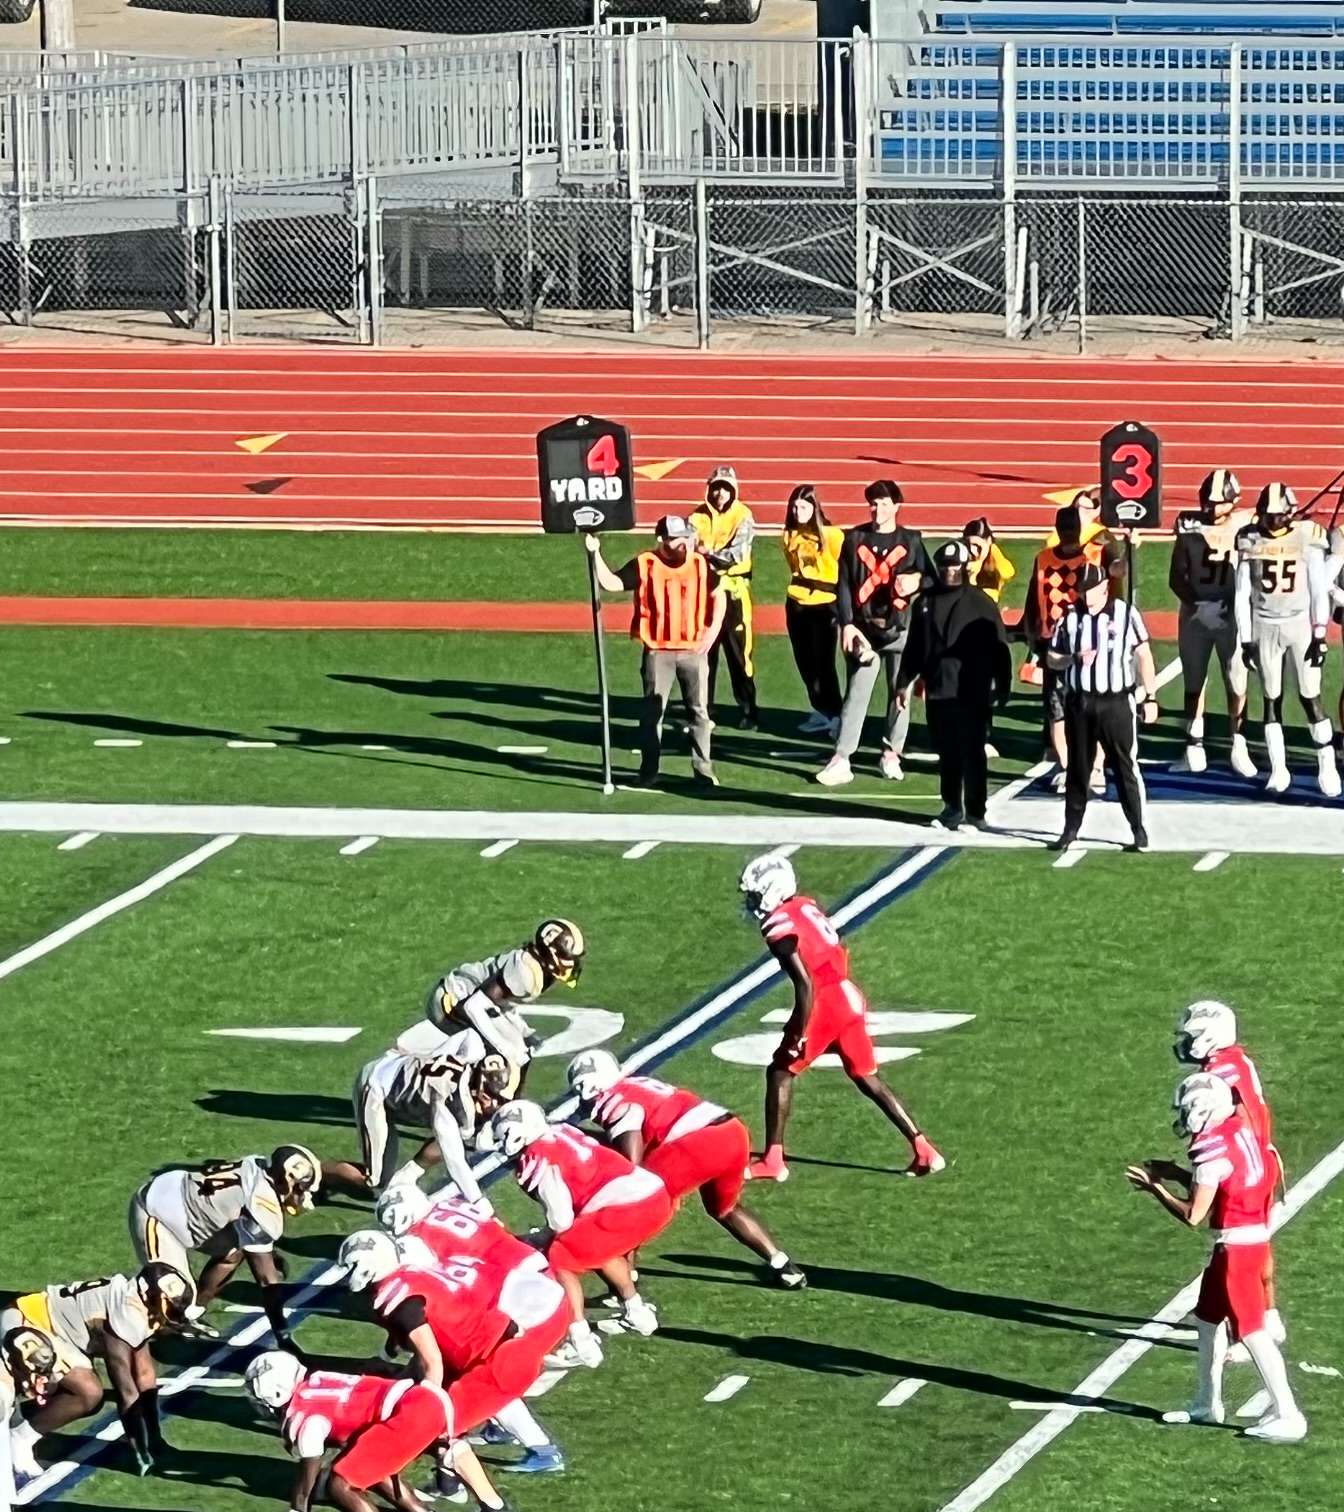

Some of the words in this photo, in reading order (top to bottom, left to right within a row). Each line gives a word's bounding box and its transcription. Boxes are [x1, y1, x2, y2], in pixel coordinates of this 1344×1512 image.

[587, 435, 619, 476] 4
[1111, 444, 1153, 498] 3
[550, 476, 623, 503] YARD
[1260, 559, 1296, 594] 55
